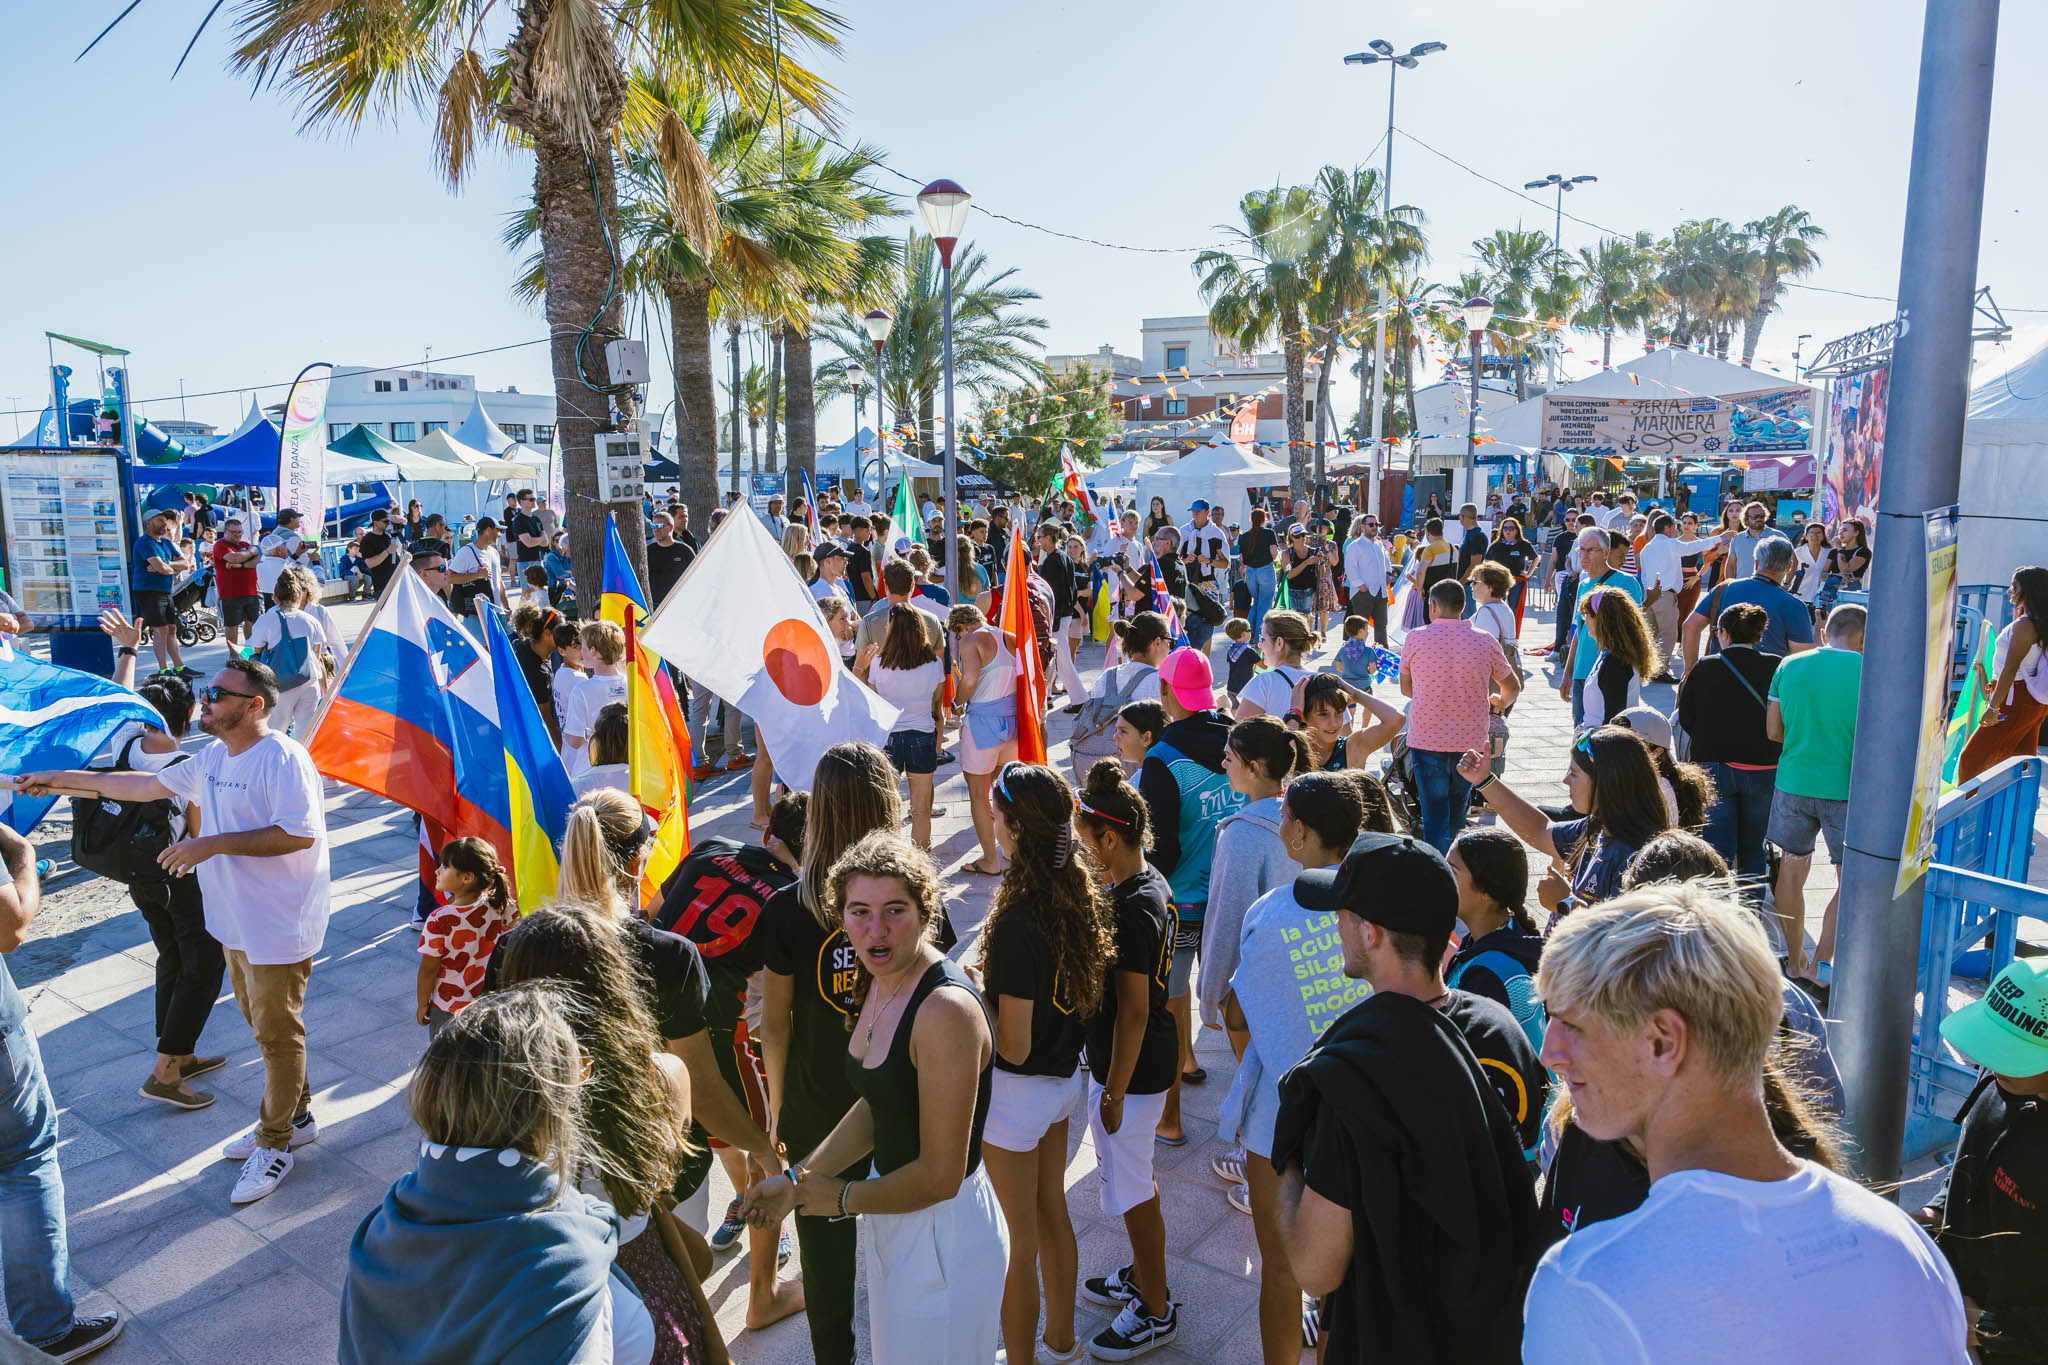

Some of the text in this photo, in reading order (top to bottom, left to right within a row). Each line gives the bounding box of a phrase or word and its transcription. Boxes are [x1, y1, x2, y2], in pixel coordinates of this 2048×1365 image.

[1631, 399, 1687, 415] FERIA
[1633, 414, 1715, 434] MARINERA
[291, 434, 300, 469] DANZA
[290, 472, 300, 485] DE
[670, 874, 762, 958] 19
[1280, 927, 1303, 944] la
[1995, 975, 2025, 1001] KEEP
